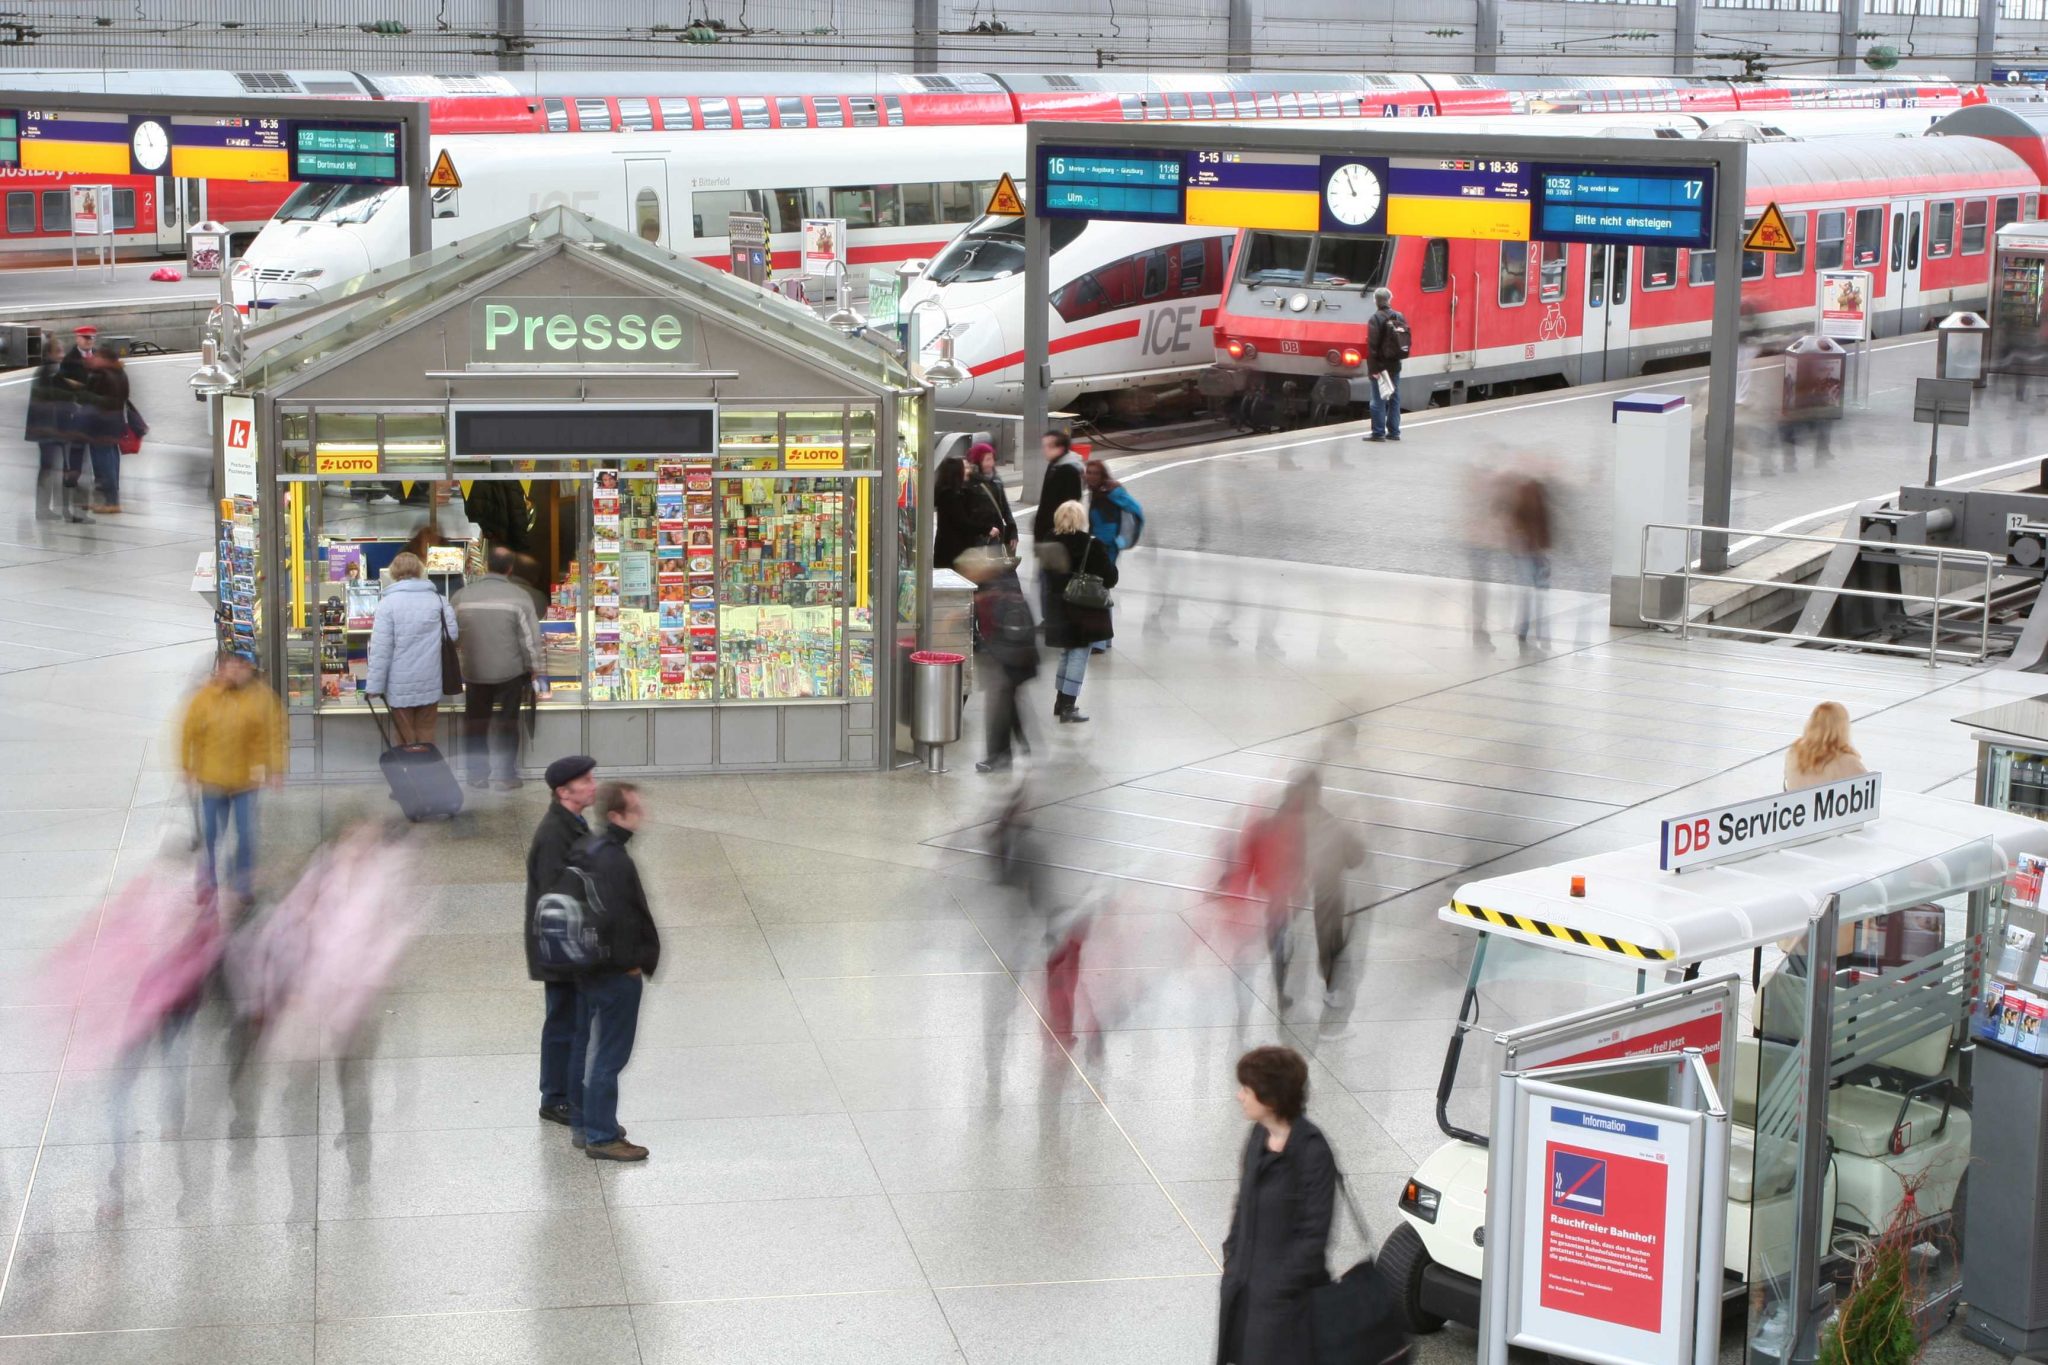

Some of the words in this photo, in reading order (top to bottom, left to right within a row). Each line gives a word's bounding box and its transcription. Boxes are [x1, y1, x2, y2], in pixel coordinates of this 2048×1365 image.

[1384, 104, 1394, 117] A
[1422, 105, 1431, 117] A
[384, 132, 394, 148] 15
[317, 161, 344, 170] Dortmund
[346, 162, 356, 170] Hbf
[1200, 152, 1220, 163] 5-15
[1226, 154, 1232, 162] U
[1049, 158, 1065, 174] 16
[1159, 164, 1180, 174] 11:49
[1489, 161, 1518, 173] 18-36
[698, 177, 730, 186] Bitterfeld
[1547, 178, 1570, 188] 10:52
[1684, 180, 1703, 199] 17
[145, 192, 152, 206] 2
[1067, 193, 1083, 202] Ulm
[1575, 214, 1596, 225] Bitte
[1600, 215, 1621, 226] nicht
[1626, 216, 1672, 230] einsteigen
[1956, 208, 1961, 225] 2
[1848, 217, 1852, 235] 2
[1530, 244, 1538, 264] 2
[486, 304, 682, 350] Presse
[1142, 306, 1196, 356] ICE
[1282, 340, 1298, 353] DB
[804, 450, 839, 460] LOTTO
[336, 460, 373, 469] LOTTO
[2011, 517, 2022, 528] 17
[1674, 818, 1710, 857] DB
[1718, 802, 1806, 845] Service
[1813, 780, 1876, 822] Mobil
[1653, 1042, 1668, 1053] frei!
[1669, 1037, 1685, 1050] Jetzt
[1701, 1041, 1720, 1054] chen!
[1582, 1114, 1626, 1132] Information
[1550, 1214, 1608, 1234] Rauchfreier
[1610, 1227, 1656, 1244] Bahnhof!
[1550, 1230, 1564, 1238] Bitte
[1565, 1233, 1590, 1244] beachten
[1602, 1241, 1615, 1250] dass
[1615, 1244, 1625, 1252] das
[1626, 1247, 1650, 1257] Rauchen
[1558, 1240, 1584, 1250] gesamten
[1585, 1245, 1631, 1260] Bahnhofsbereich
[1550, 1246, 1574, 1256] gestattet
[1585, 1254, 1625, 1267] Ausgenommen
[1559, 1255, 1607, 1271] gekennzeichneten
